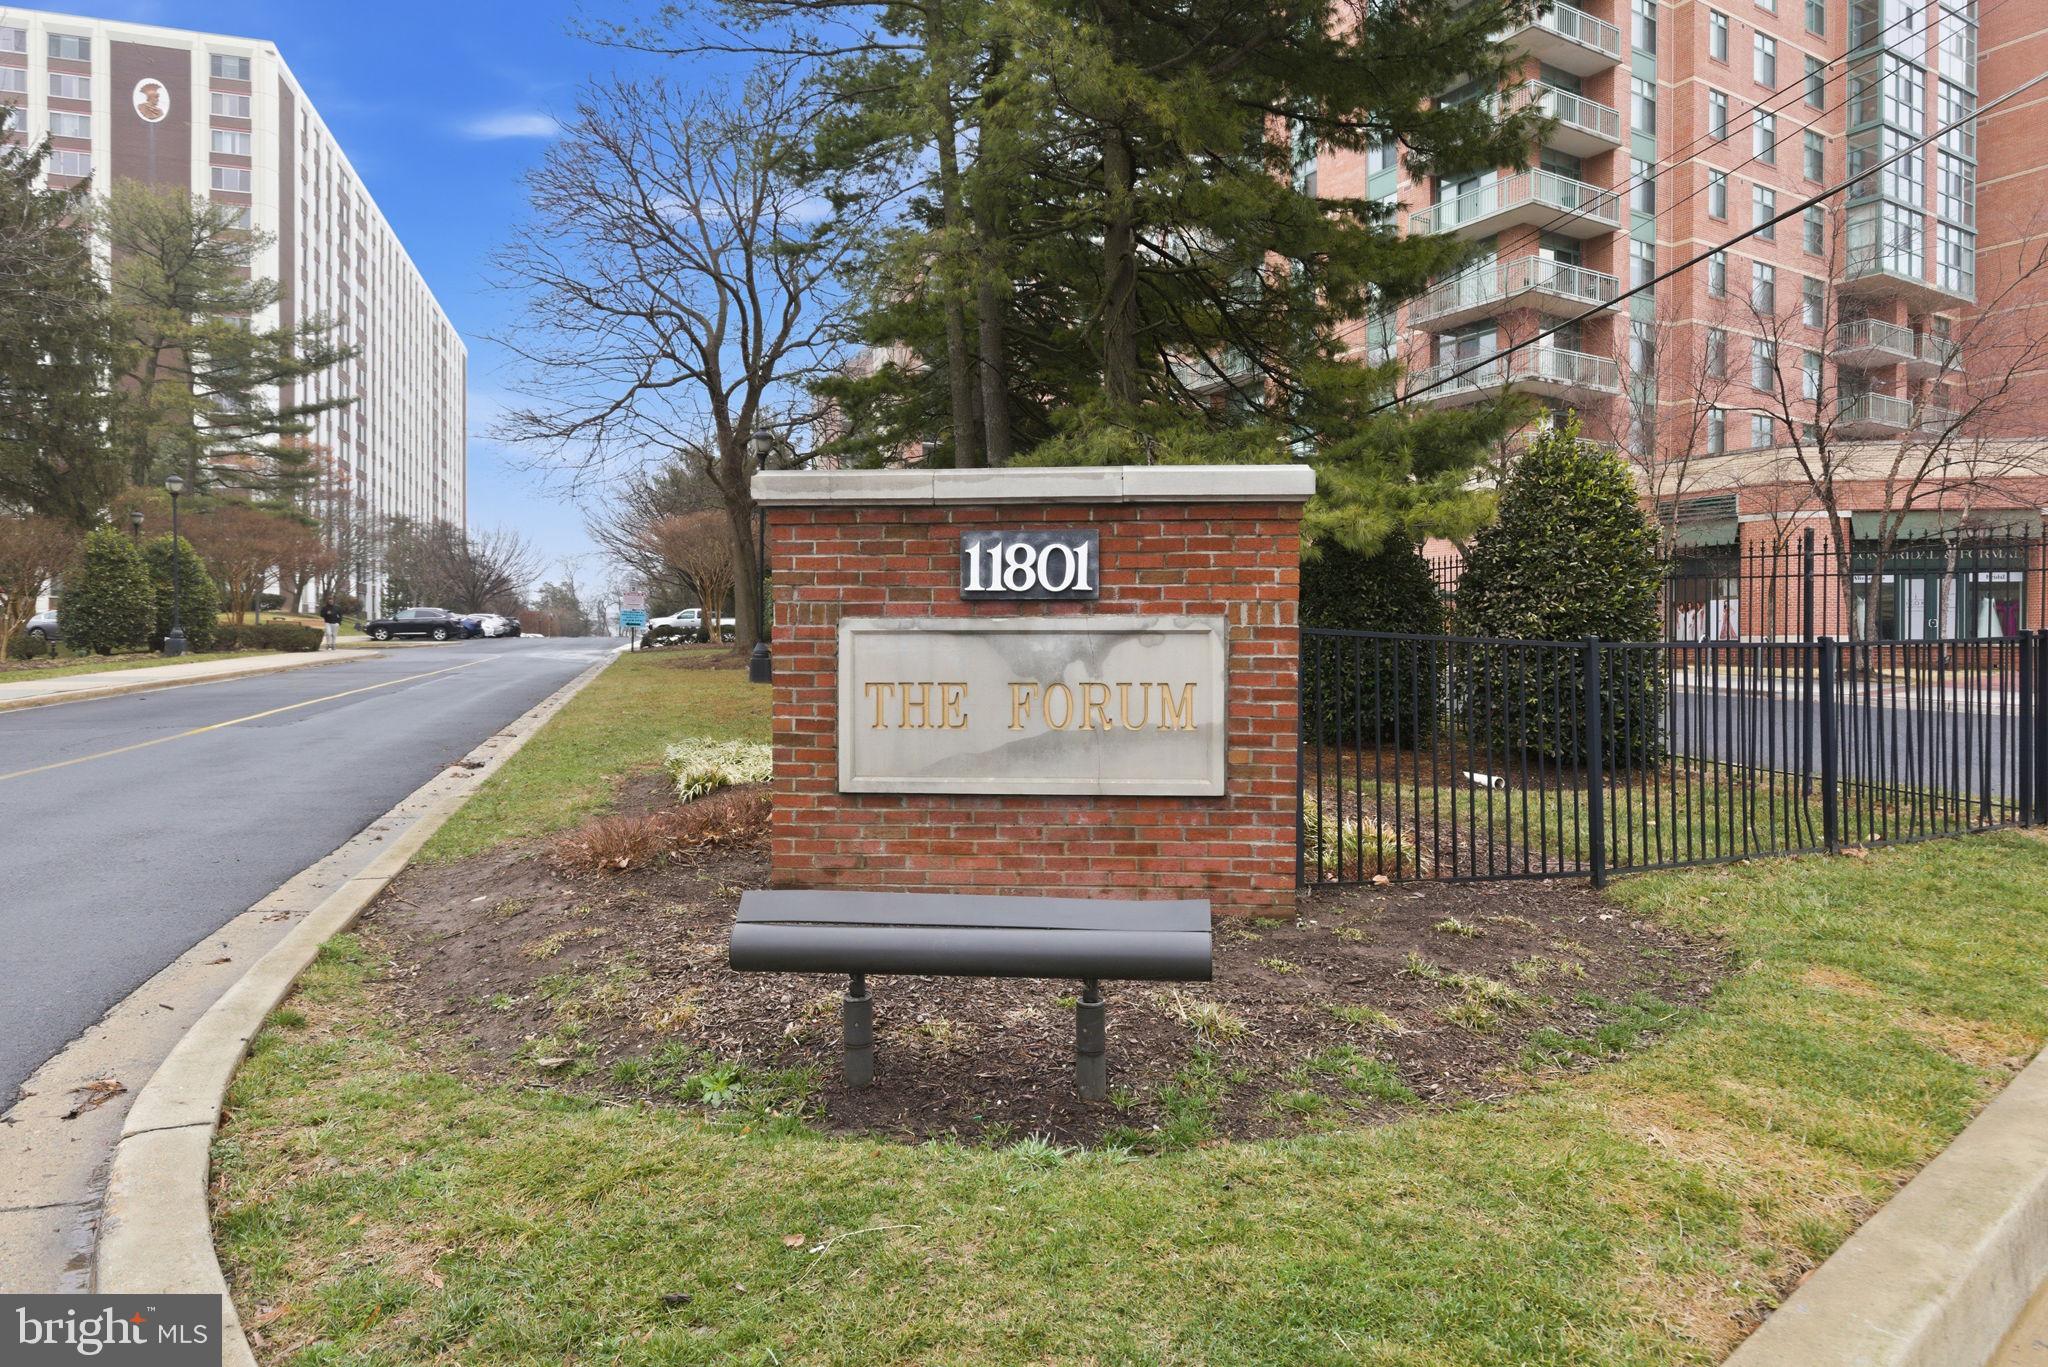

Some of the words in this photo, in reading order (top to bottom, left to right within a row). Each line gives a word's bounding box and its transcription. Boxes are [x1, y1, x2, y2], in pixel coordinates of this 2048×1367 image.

[964, 540, 1093, 592] 11801
[864, 681, 969, 731] THE
[1007, 681, 1198, 732] FORUM
